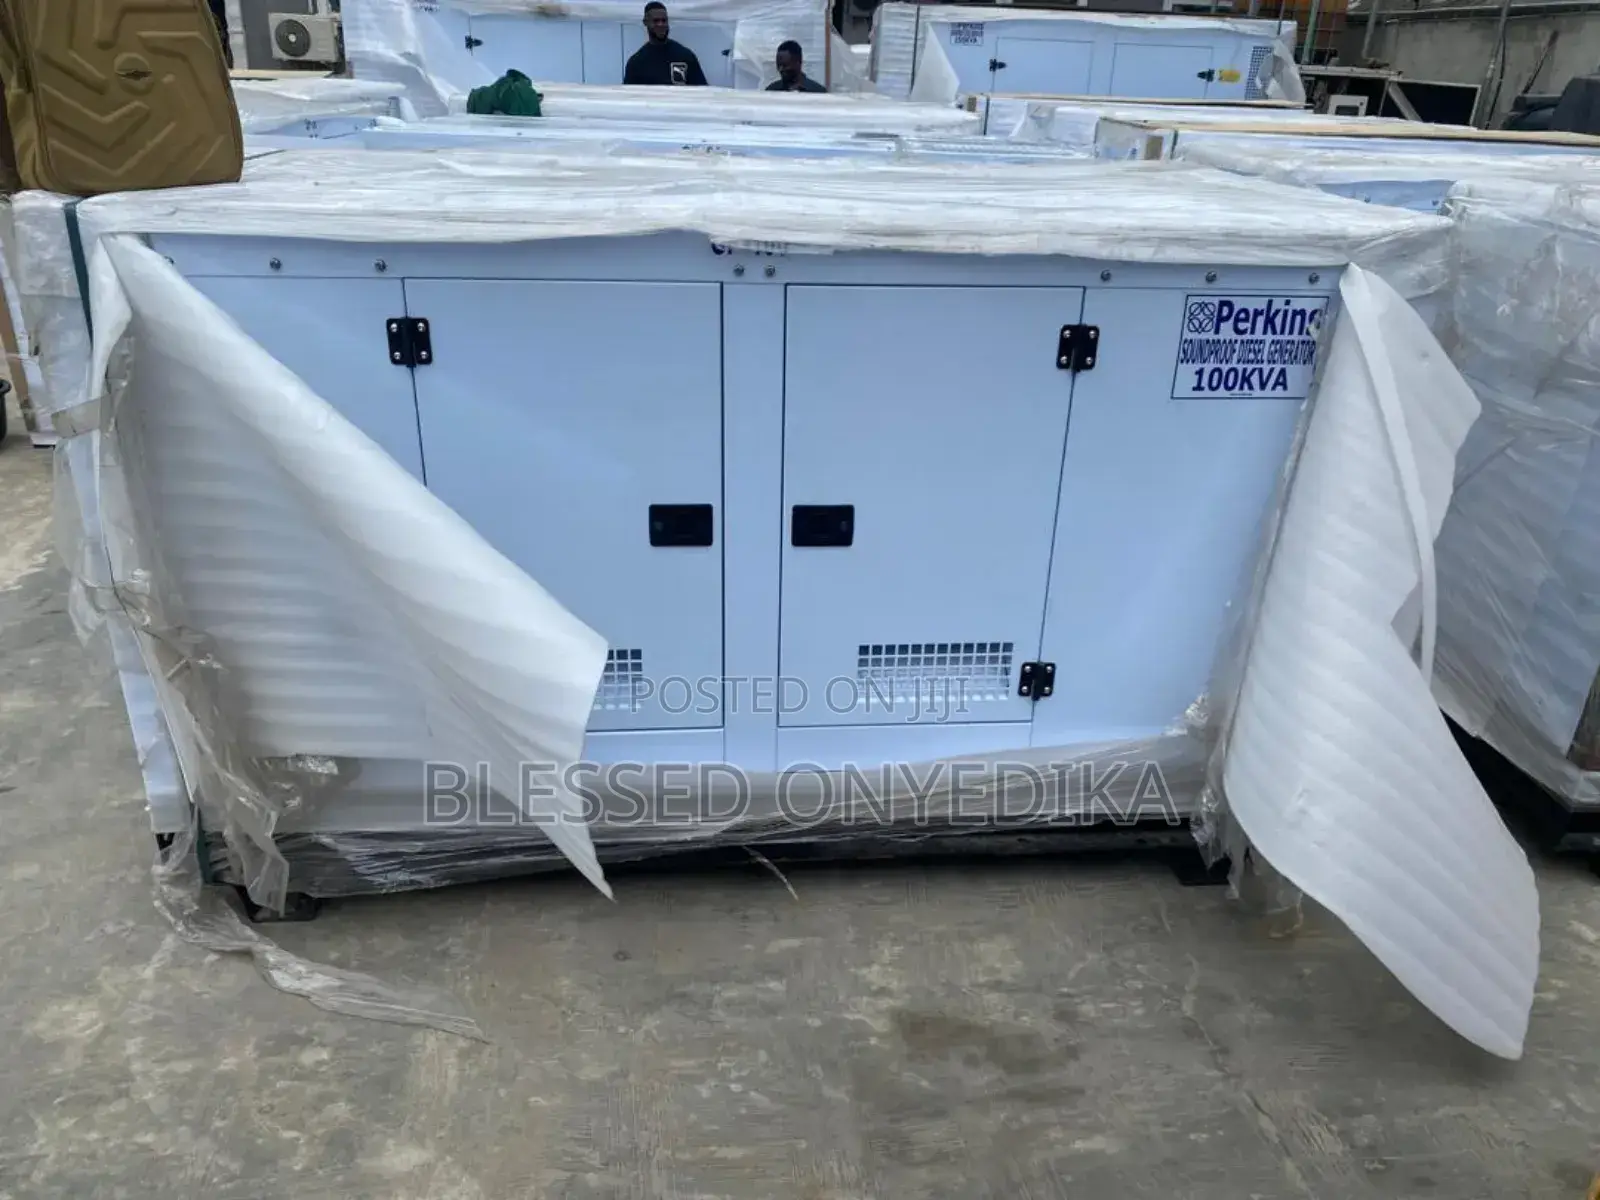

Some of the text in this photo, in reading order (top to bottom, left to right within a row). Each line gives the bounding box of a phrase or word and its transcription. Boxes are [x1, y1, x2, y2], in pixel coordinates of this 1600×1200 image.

[1180, 338, 1317, 365] SOUNDPROOF DIESEL GENERATOR
[1192, 367, 1288, 392] 100KVA
